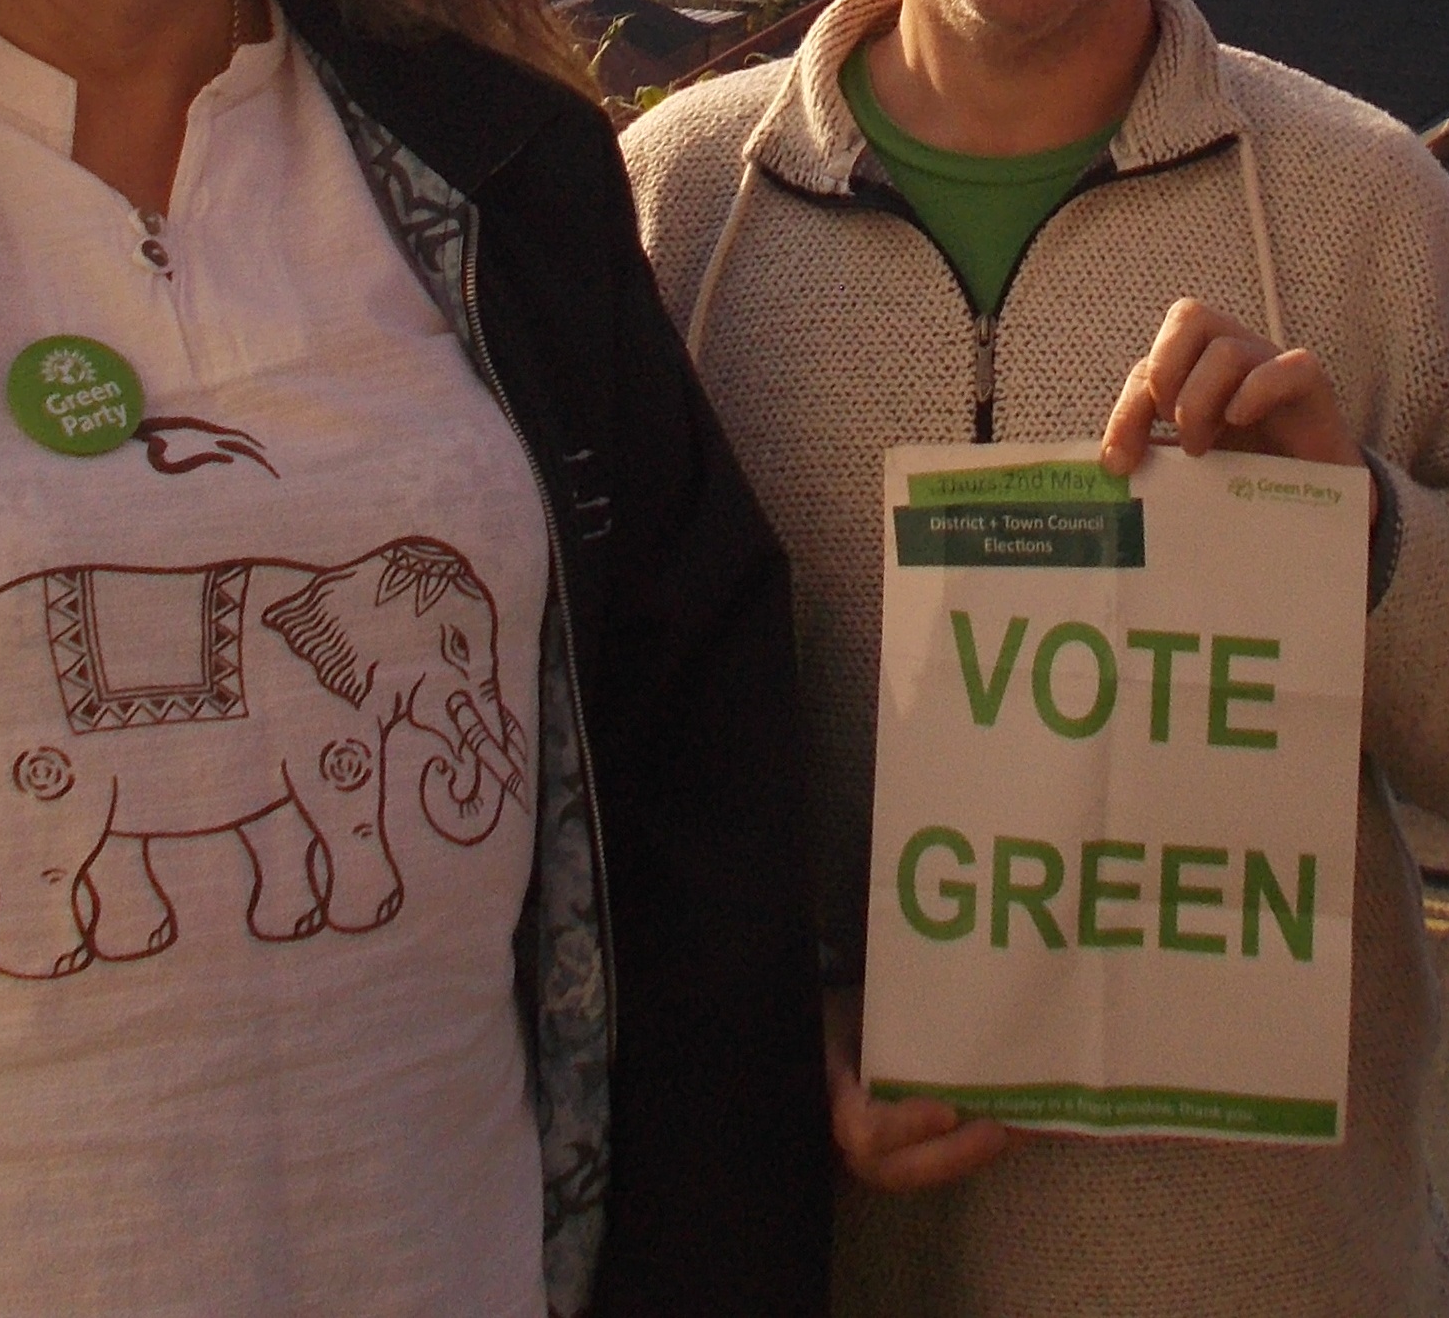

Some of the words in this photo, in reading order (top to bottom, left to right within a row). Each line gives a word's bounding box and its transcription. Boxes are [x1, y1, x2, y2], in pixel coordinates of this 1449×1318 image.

[45, 380, 123, 416] Green
[61, 403, 128, 437] Party
[939, 478, 998, 496] Thurs
[1004, 469, 1044, 492] 2nd
[1050, 468, 1097, 496] May
[1257, 478, 1301, 495] Green
[1303, 482, 1343, 503] Party
[929, 516, 985, 531] District
[988, 518, 998, 528] +
[1002, 515, 1044, 531] Town
[1047, 514, 1104, 531] Council
[983, 537, 1054, 554] Elections
[949, 609, 1282, 751] VOTE
[895, 824, 1319, 963] GREEN
